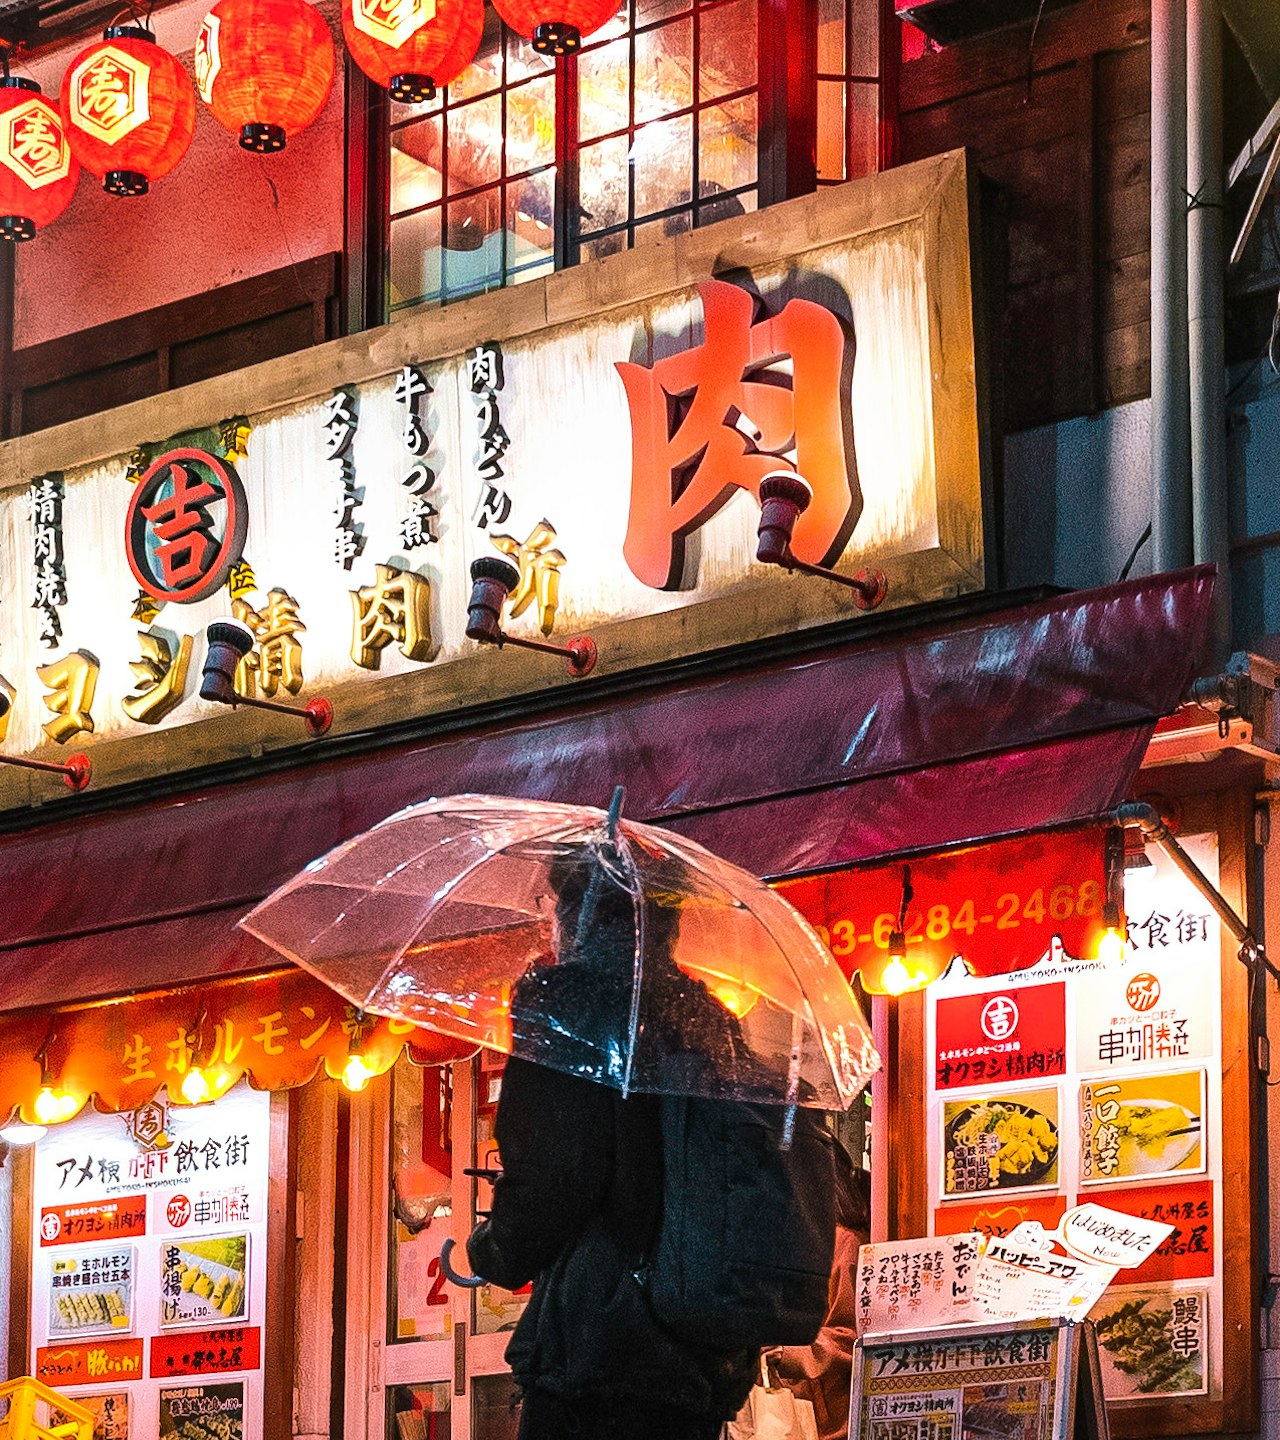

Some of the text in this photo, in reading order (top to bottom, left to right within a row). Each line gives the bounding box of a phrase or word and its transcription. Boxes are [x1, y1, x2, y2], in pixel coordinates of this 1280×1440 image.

[395, 366, 437, 549] 牛もつ煮
[469, 346, 511, 529] 肉うどん
[620, 280, 854, 590] 肉
[324, 391, 362, 570] スタミナ串
[26, 478, 65, 650] 精肉焼き
[140, 464, 218, 590] 吉
[936, 1051, 1066, 1083] オクヨシ精肉所
[1093, 1084, 1121, 1176] 一口餃子
[81, 1254, 130, 1271] 生ホルモン
[952, 1241, 975, 1297] おでん
[988, 1246, 1084, 1279] ハッピーアワー
[1071, 1212, 1152, 1254] はじめました
[162, 1245, 182, 1321] 串揚げ
[1171, 1297, 1200, 1359] 鰻串
